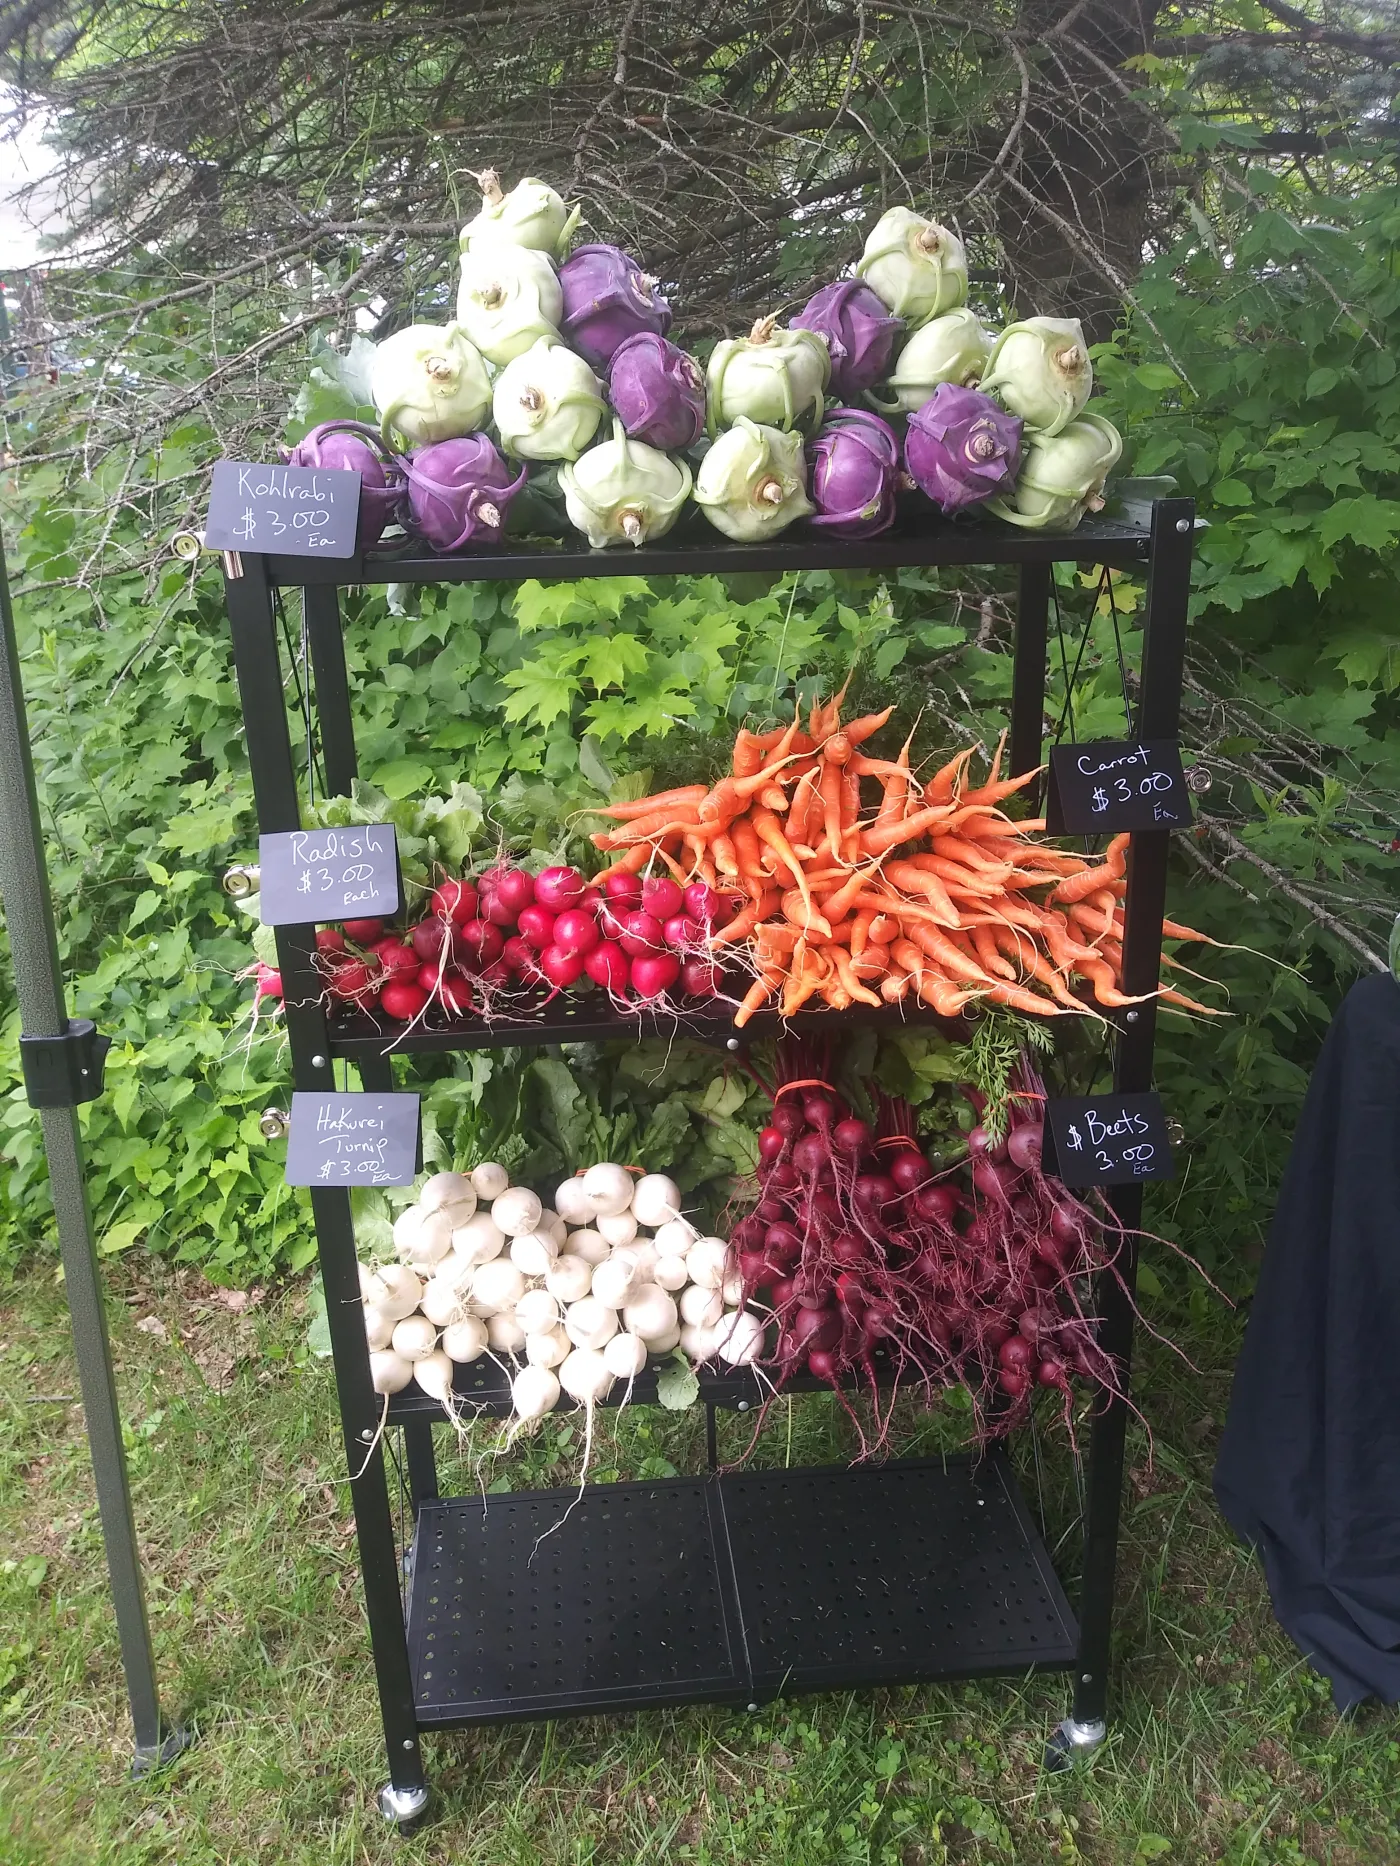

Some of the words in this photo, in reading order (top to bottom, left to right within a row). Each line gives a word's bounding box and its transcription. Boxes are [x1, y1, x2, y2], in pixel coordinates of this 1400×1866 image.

[238, 468, 334, 503] Kohlrabi
[1077, 744, 1151, 776] Carrot
[1153, 801, 1178, 821] Ea
[289, 825, 383, 865] Radish
[1084, 1109, 1149, 1145] Beets
[319, 1135, 388, 1163] Turnip
[1095, 1144, 1154, 1170] 3.00
[1133, 1162, 1155, 1175] Ea
